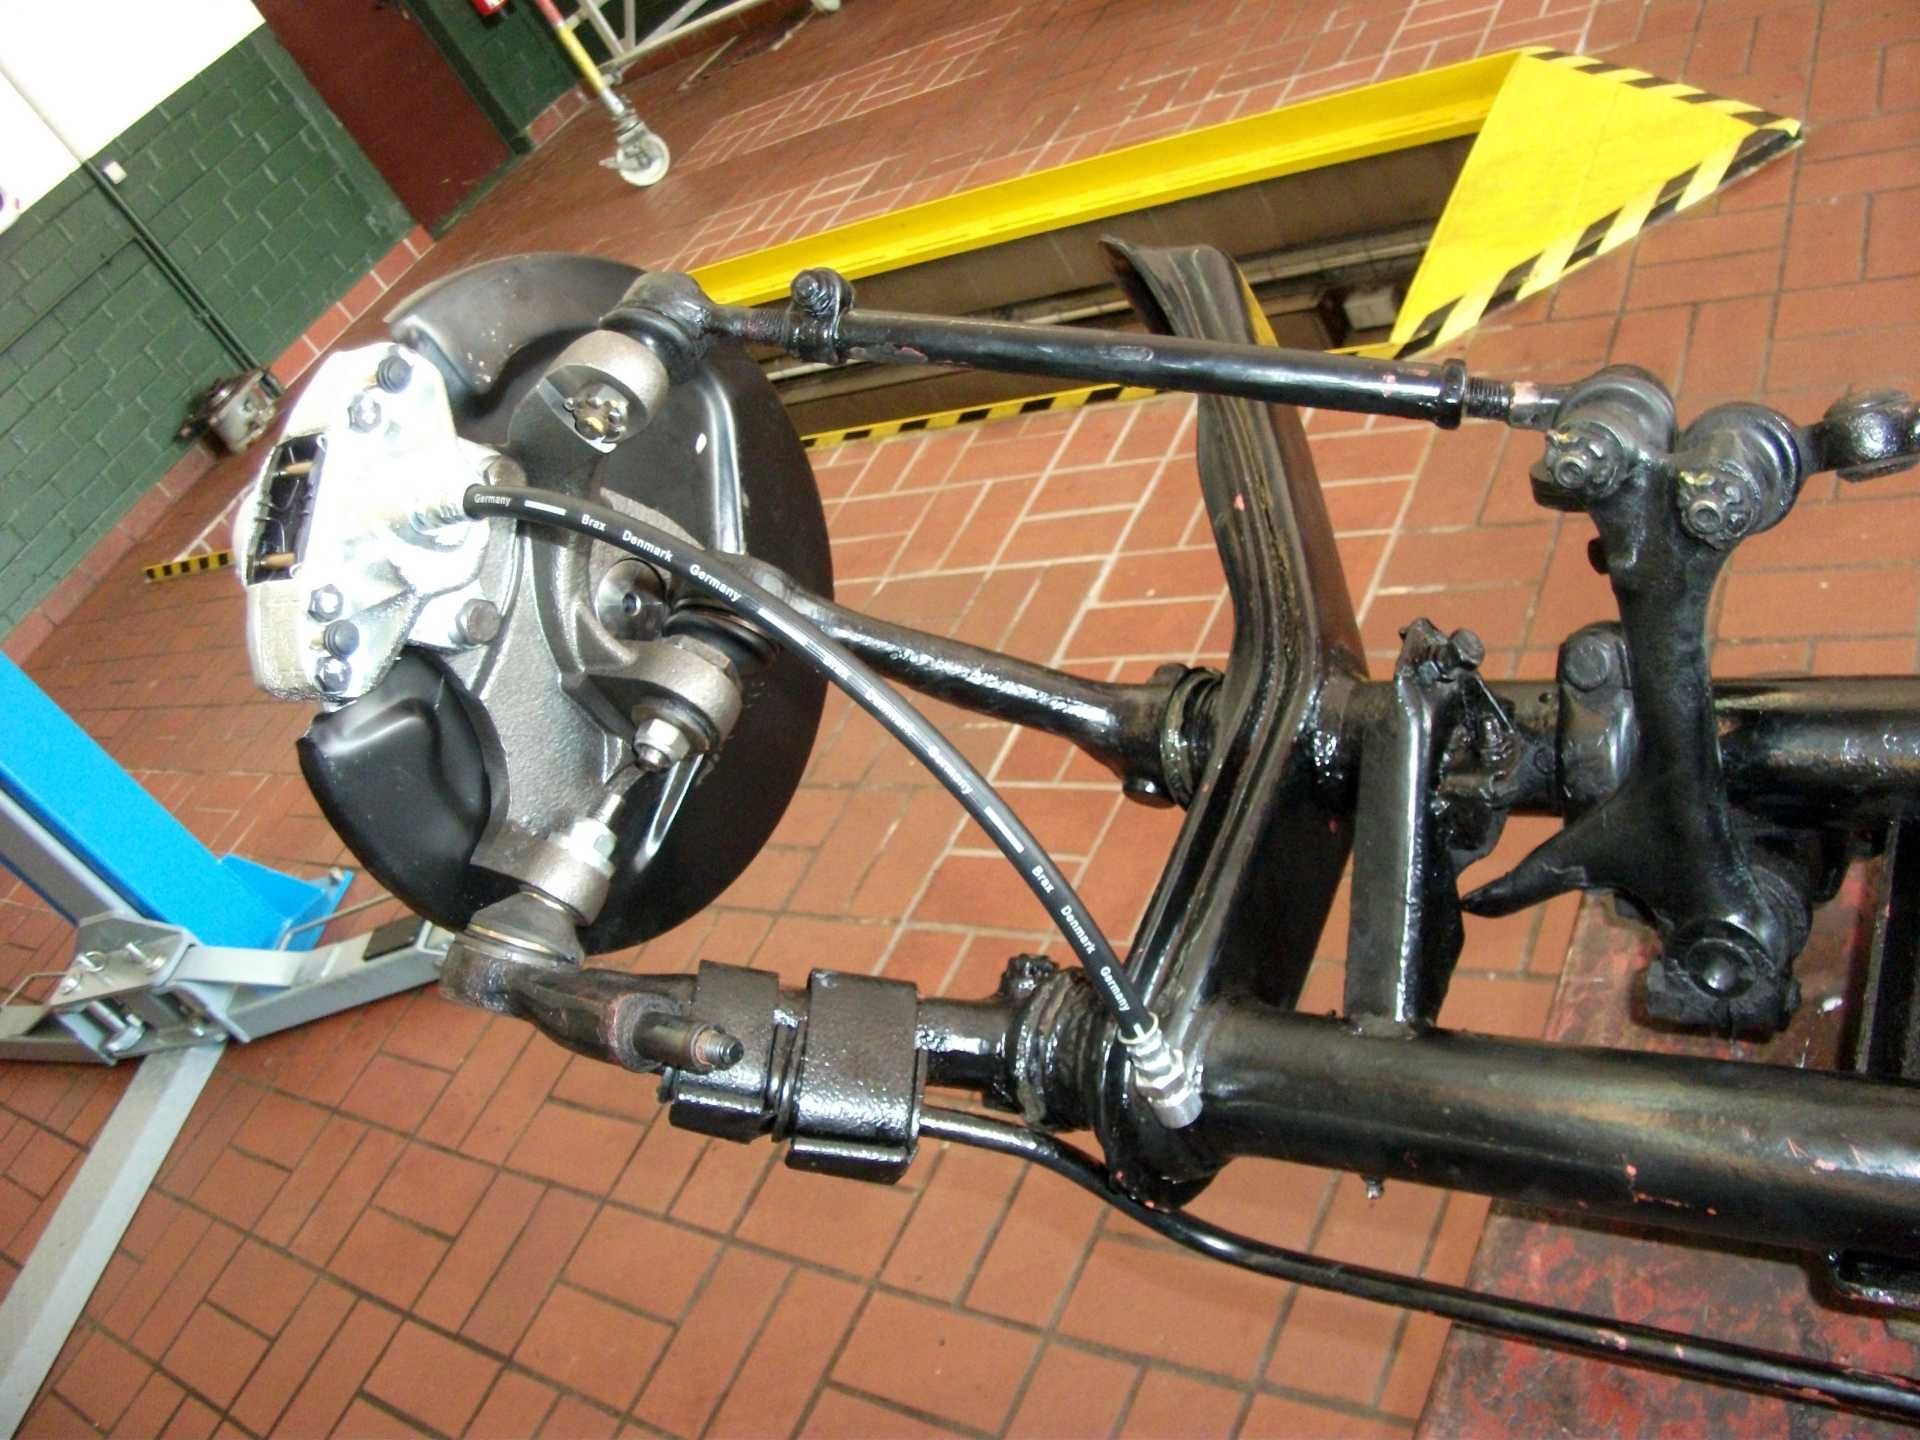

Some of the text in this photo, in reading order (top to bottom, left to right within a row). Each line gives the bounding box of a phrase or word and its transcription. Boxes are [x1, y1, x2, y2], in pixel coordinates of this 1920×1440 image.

[474, 493, 511, 507] Germany
[581, 514, 741, 602] Brax Denmark Germany
[1031, 865, 1130, 1011] Brax Denmark Germany
